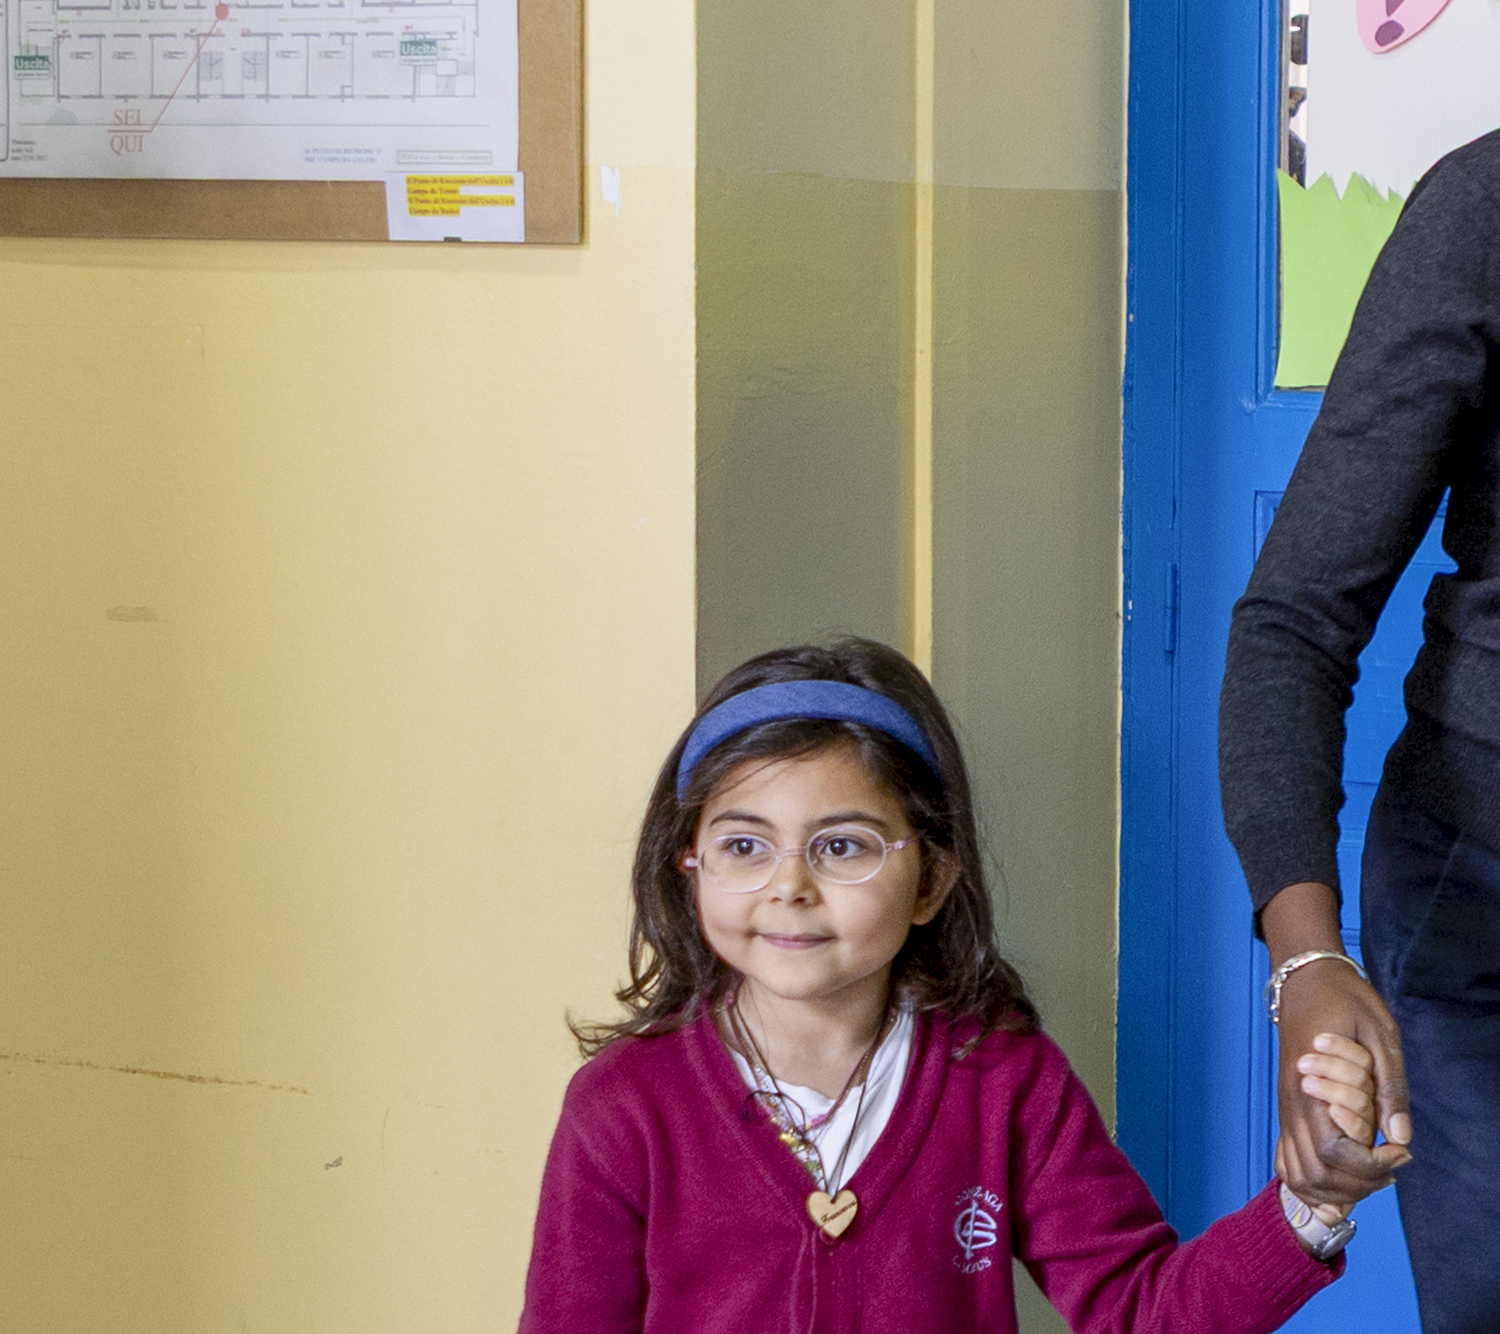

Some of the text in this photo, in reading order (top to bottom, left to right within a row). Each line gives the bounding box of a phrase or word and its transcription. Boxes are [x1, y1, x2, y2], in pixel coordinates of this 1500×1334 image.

[403, 42, 437, 55] Uscita
[16, 57, 50, 69] Uscita
[113, 108, 142, 127] SEI
[109, 134, 144, 156] QUI
